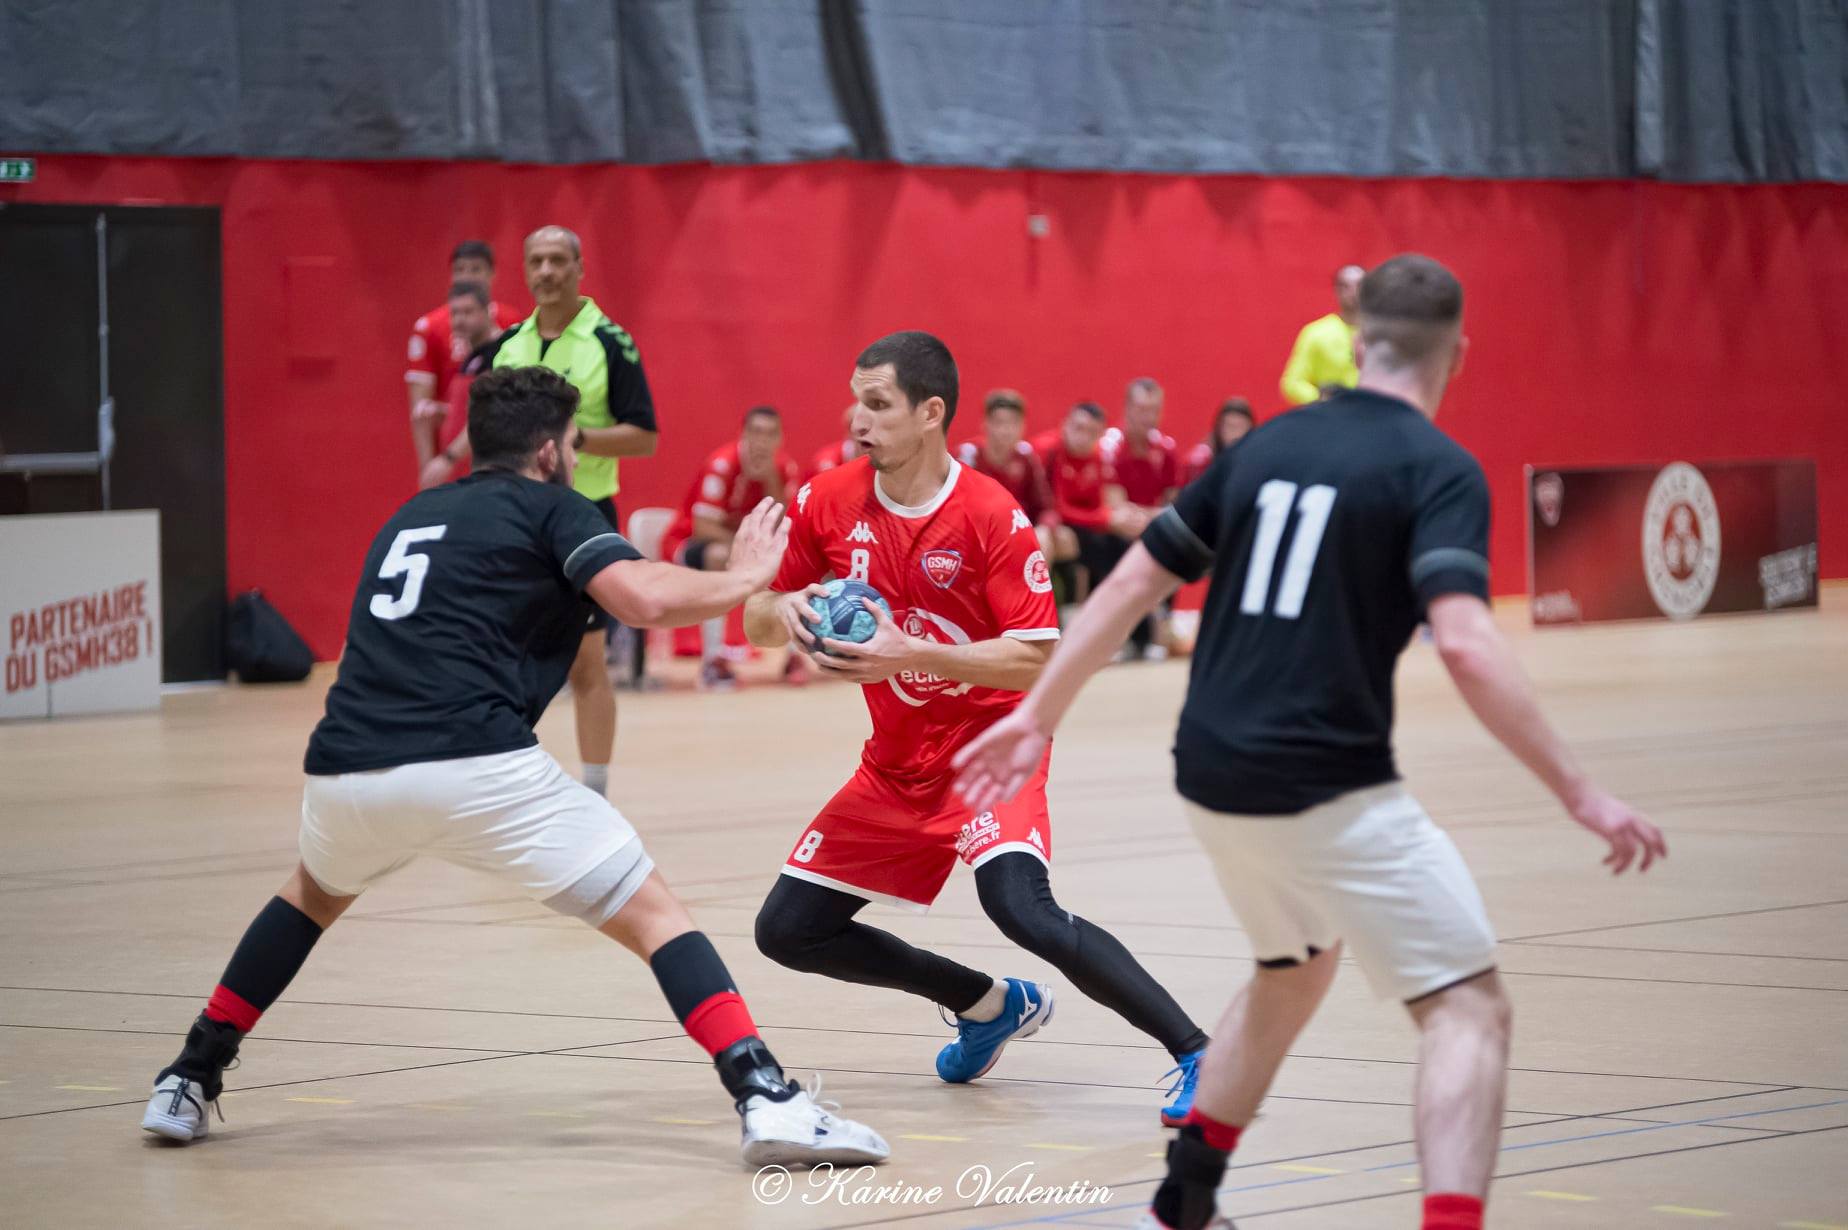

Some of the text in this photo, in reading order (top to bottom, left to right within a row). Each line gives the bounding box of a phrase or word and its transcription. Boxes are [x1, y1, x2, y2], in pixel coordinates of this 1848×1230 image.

[850, 548, 869, 584] 8
[927, 556, 958, 571] GSMH
[1240, 478, 1338, 619] 11
[369, 524, 447, 620] 5
[10, 579, 147, 650] PARTENAIRE
[5, 650, 37, 694] DU
[793, 829, 823, 863] 8
